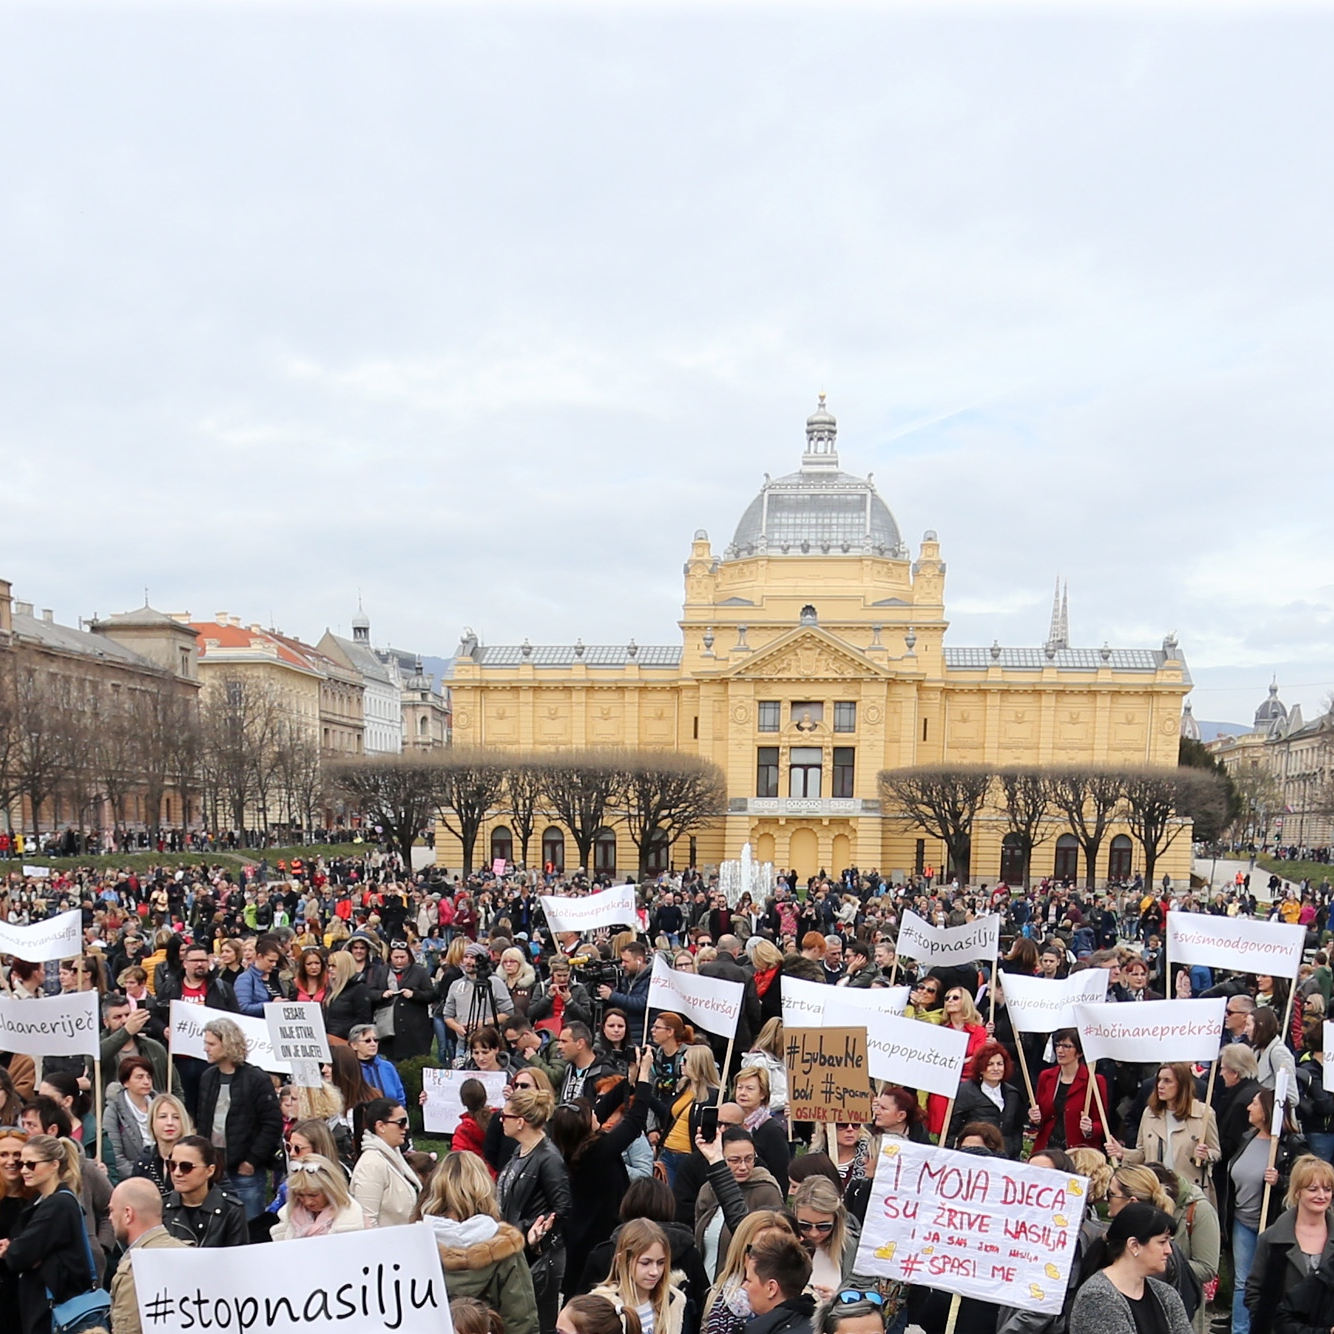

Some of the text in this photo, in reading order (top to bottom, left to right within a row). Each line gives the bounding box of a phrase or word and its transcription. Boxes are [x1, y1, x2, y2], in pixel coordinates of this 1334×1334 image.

[902, 925, 995, 953] #stopnasilju
[1172, 930, 1295, 956] #svismoodgovorni
[280, 1045, 292, 1058] ON
[792, 1075, 814, 1101] boli
[830, 1107, 843, 1121] TE
[893, 1154, 1066, 1211] I MOJA DJECA
[883, 1196, 919, 1220] SU
[932, 1201, 992, 1234] ŽRTVE
[923, 1230, 940, 1243] JA
[990, 1264, 1018, 1283] ME
